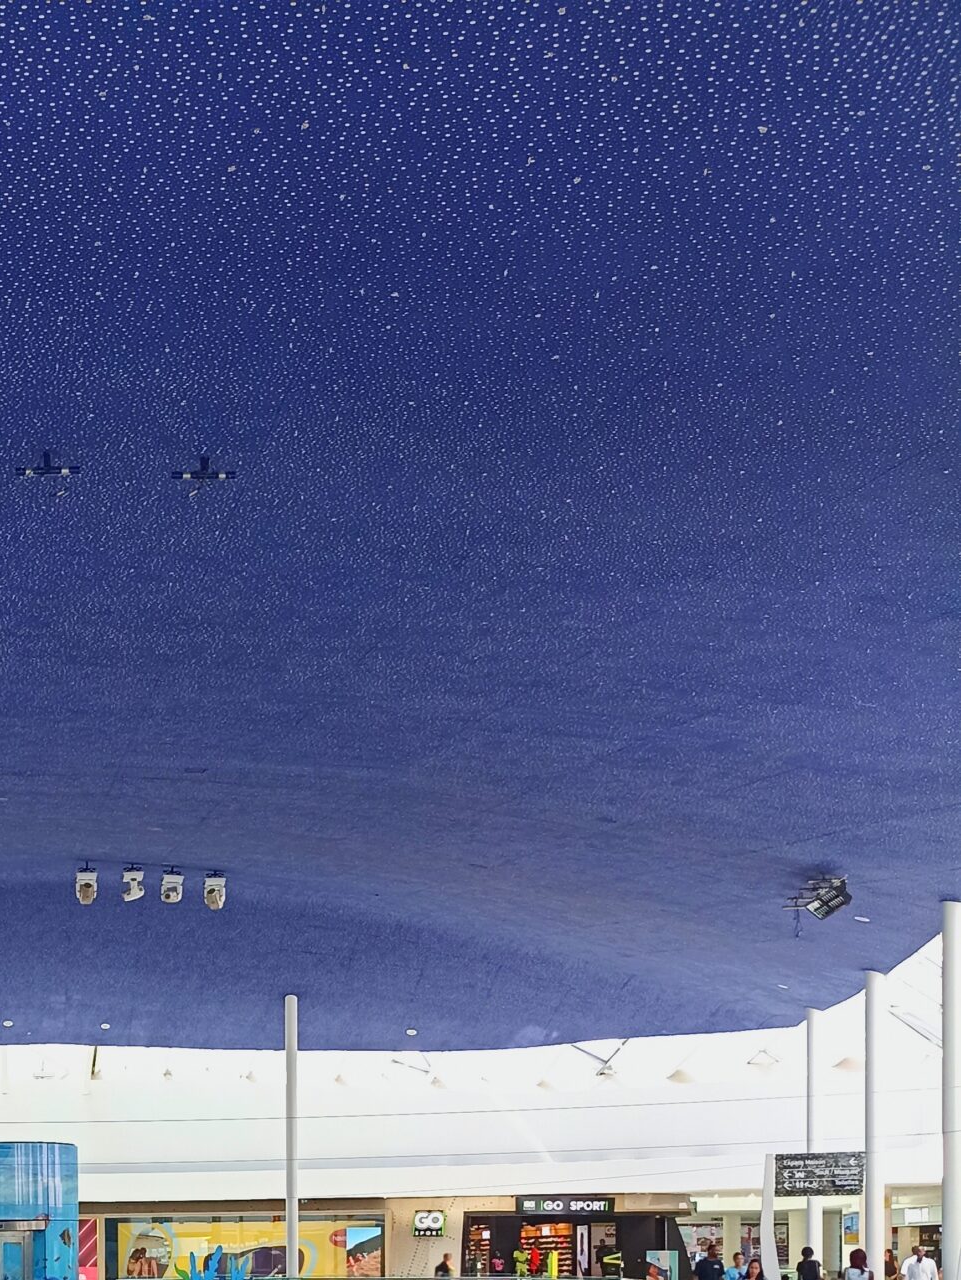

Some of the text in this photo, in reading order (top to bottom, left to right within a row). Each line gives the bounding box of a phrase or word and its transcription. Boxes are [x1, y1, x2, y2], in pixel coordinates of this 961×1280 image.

[543, 1200, 606, 1211] GO SPORT
[414, 1211, 444, 1230] GO
